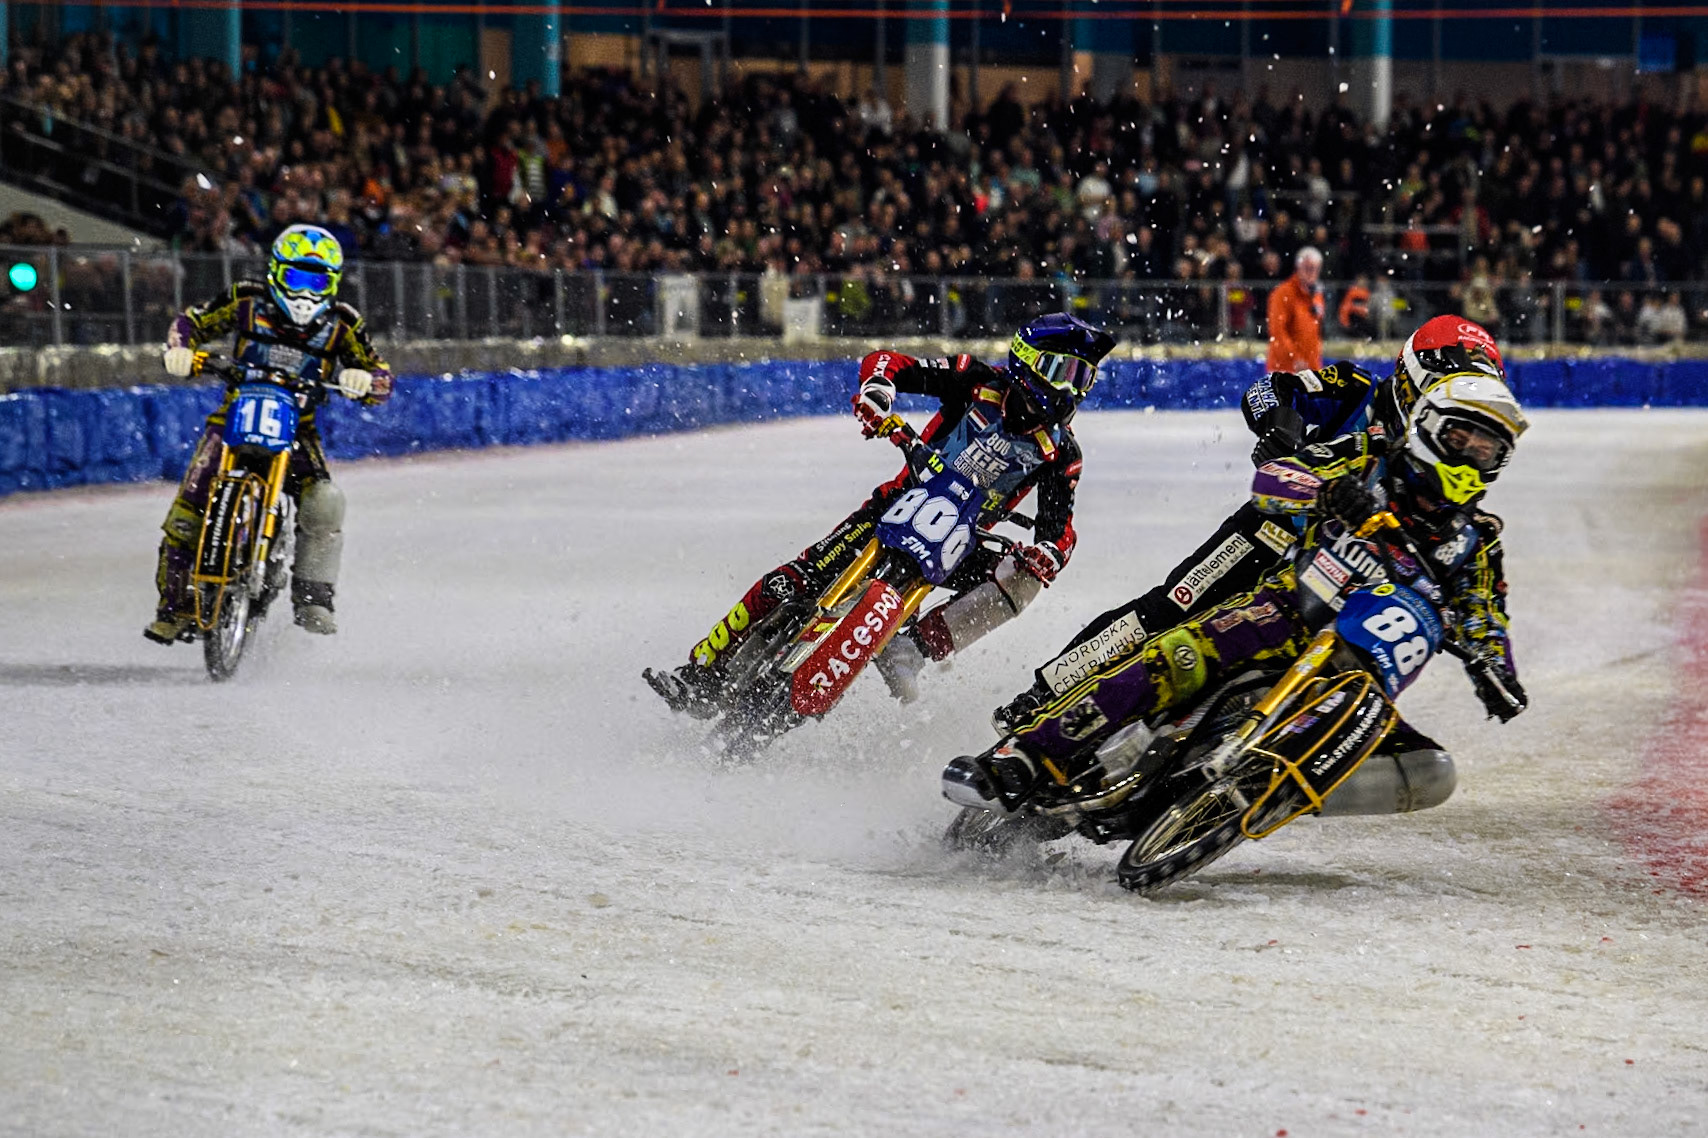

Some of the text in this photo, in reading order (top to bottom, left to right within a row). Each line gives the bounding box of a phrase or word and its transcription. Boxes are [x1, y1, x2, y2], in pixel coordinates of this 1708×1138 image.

[241, 399, 281, 438] 16
[964, 437, 1010, 476] ICE
[986, 432, 1011, 456] 800
[816, 521, 872, 572] Happy Smile
[881, 488, 971, 571] 800
[901, 535, 932, 561] FIM
[1316, 553, 1351, 584] MOTUL
[1053, 627, 1146, 695] CENTRUMHUS
[1054, 619, 1129, 676] NORDISKA
[1362, 606, 1429, 676] 88
